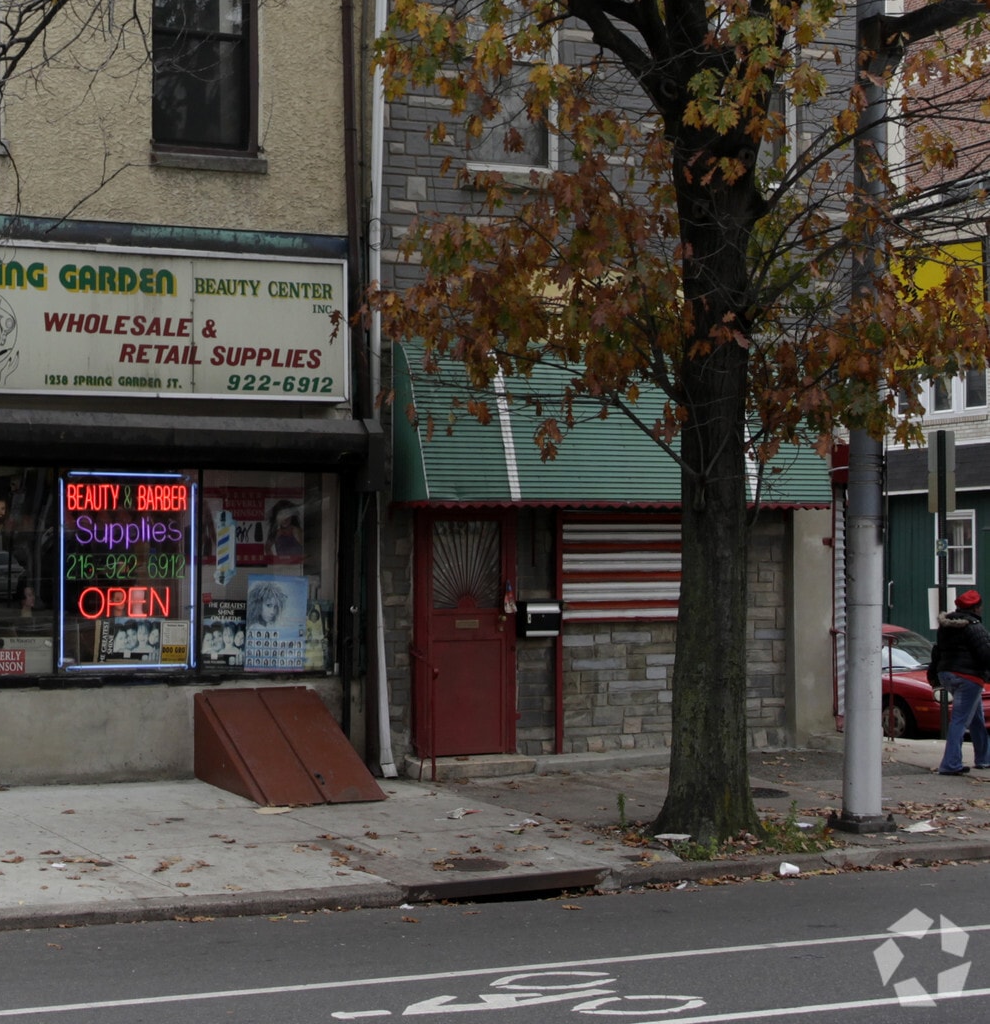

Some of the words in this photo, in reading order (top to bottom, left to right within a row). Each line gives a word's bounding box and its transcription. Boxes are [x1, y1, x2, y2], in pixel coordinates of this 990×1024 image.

[58, 264, 177, 297] GARDEN
[194, 277, 261, 297] BEAUTY
[268, 280, 333, 301] CENTER
[44, 312, 193, 337] WHOLESALE
[202, 319, 217, 338] &
[119, 343, 202, 365] RETAIL
[210, 345, 322, 369] SUPPLIES
[73, 375, 112, 387] SPRING
[118, 376, 161, 389] GARDEN
[166, 378, 182, 389] ST.
[227, 374, 333, 393] 922-6912
[67, 484, 120, 511] BEAUTY
[124, 485, 132, 510] &
[138, 484, 187, 511] BARBER
[75, 515, 182, 550] Supplies
[66, 553, 138, 579] 215-922
[147, 553, 186, 579] 6912
[78, 586, 170, 619] OPEN
